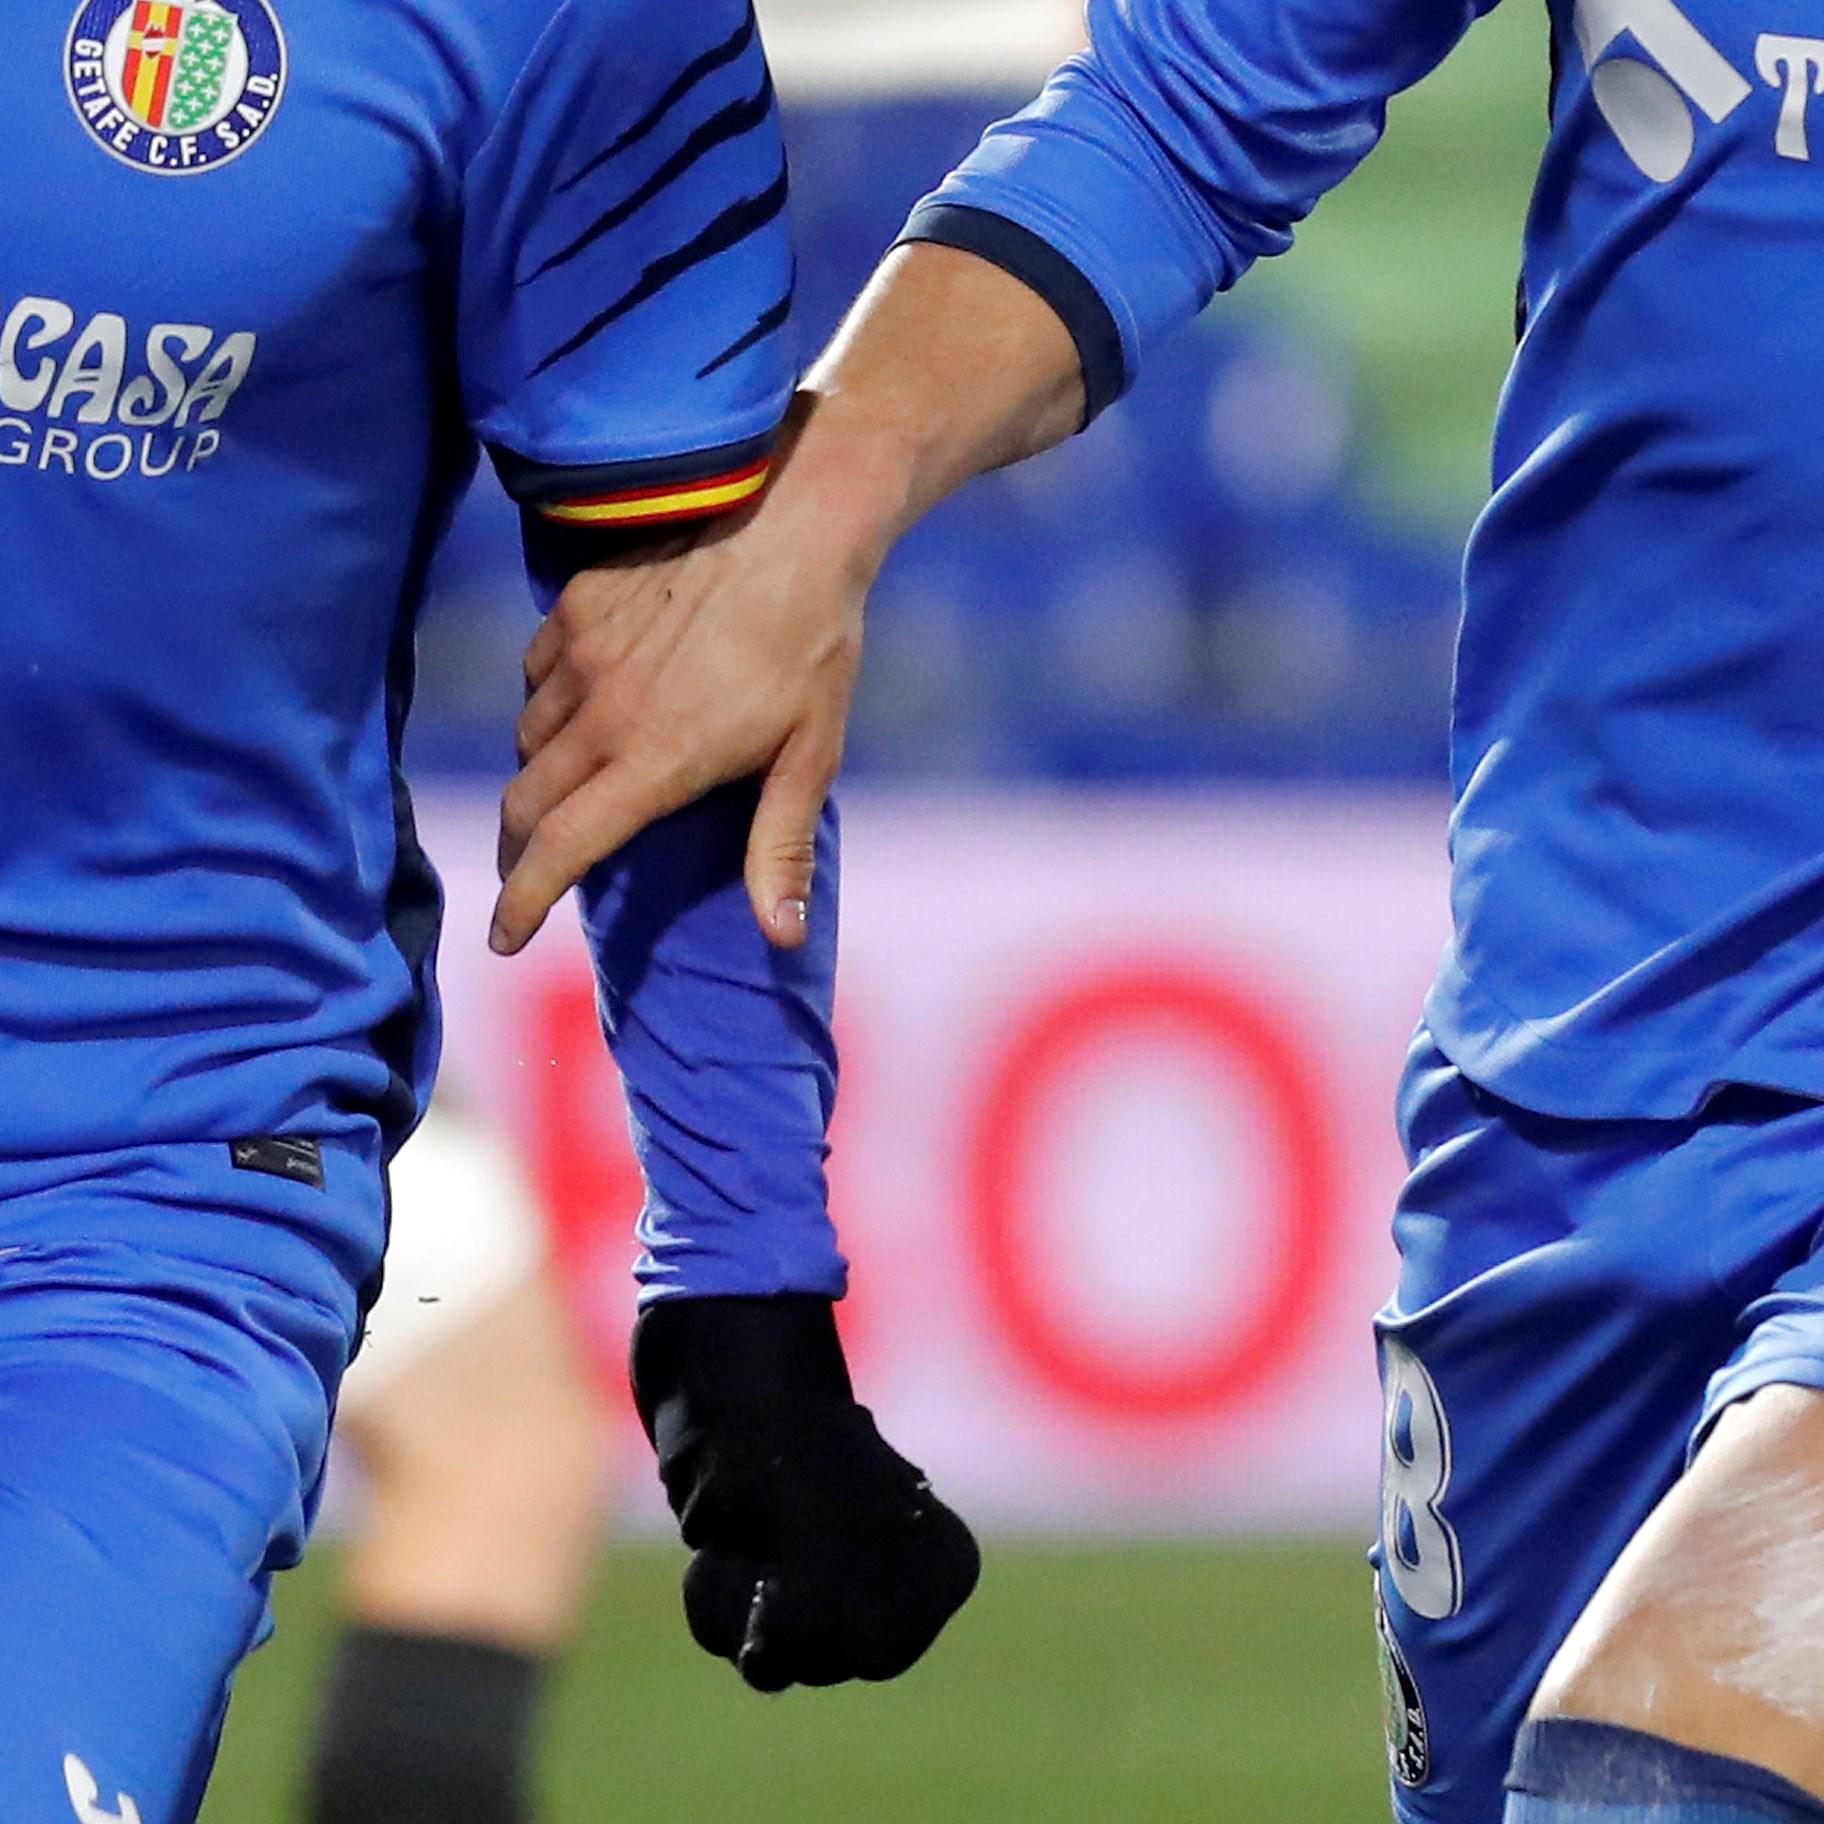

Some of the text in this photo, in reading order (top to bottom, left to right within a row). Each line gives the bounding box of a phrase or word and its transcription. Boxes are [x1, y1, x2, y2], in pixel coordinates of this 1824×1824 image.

[74, 38, 278, 167] GETAFE C.F. S.A.D.
